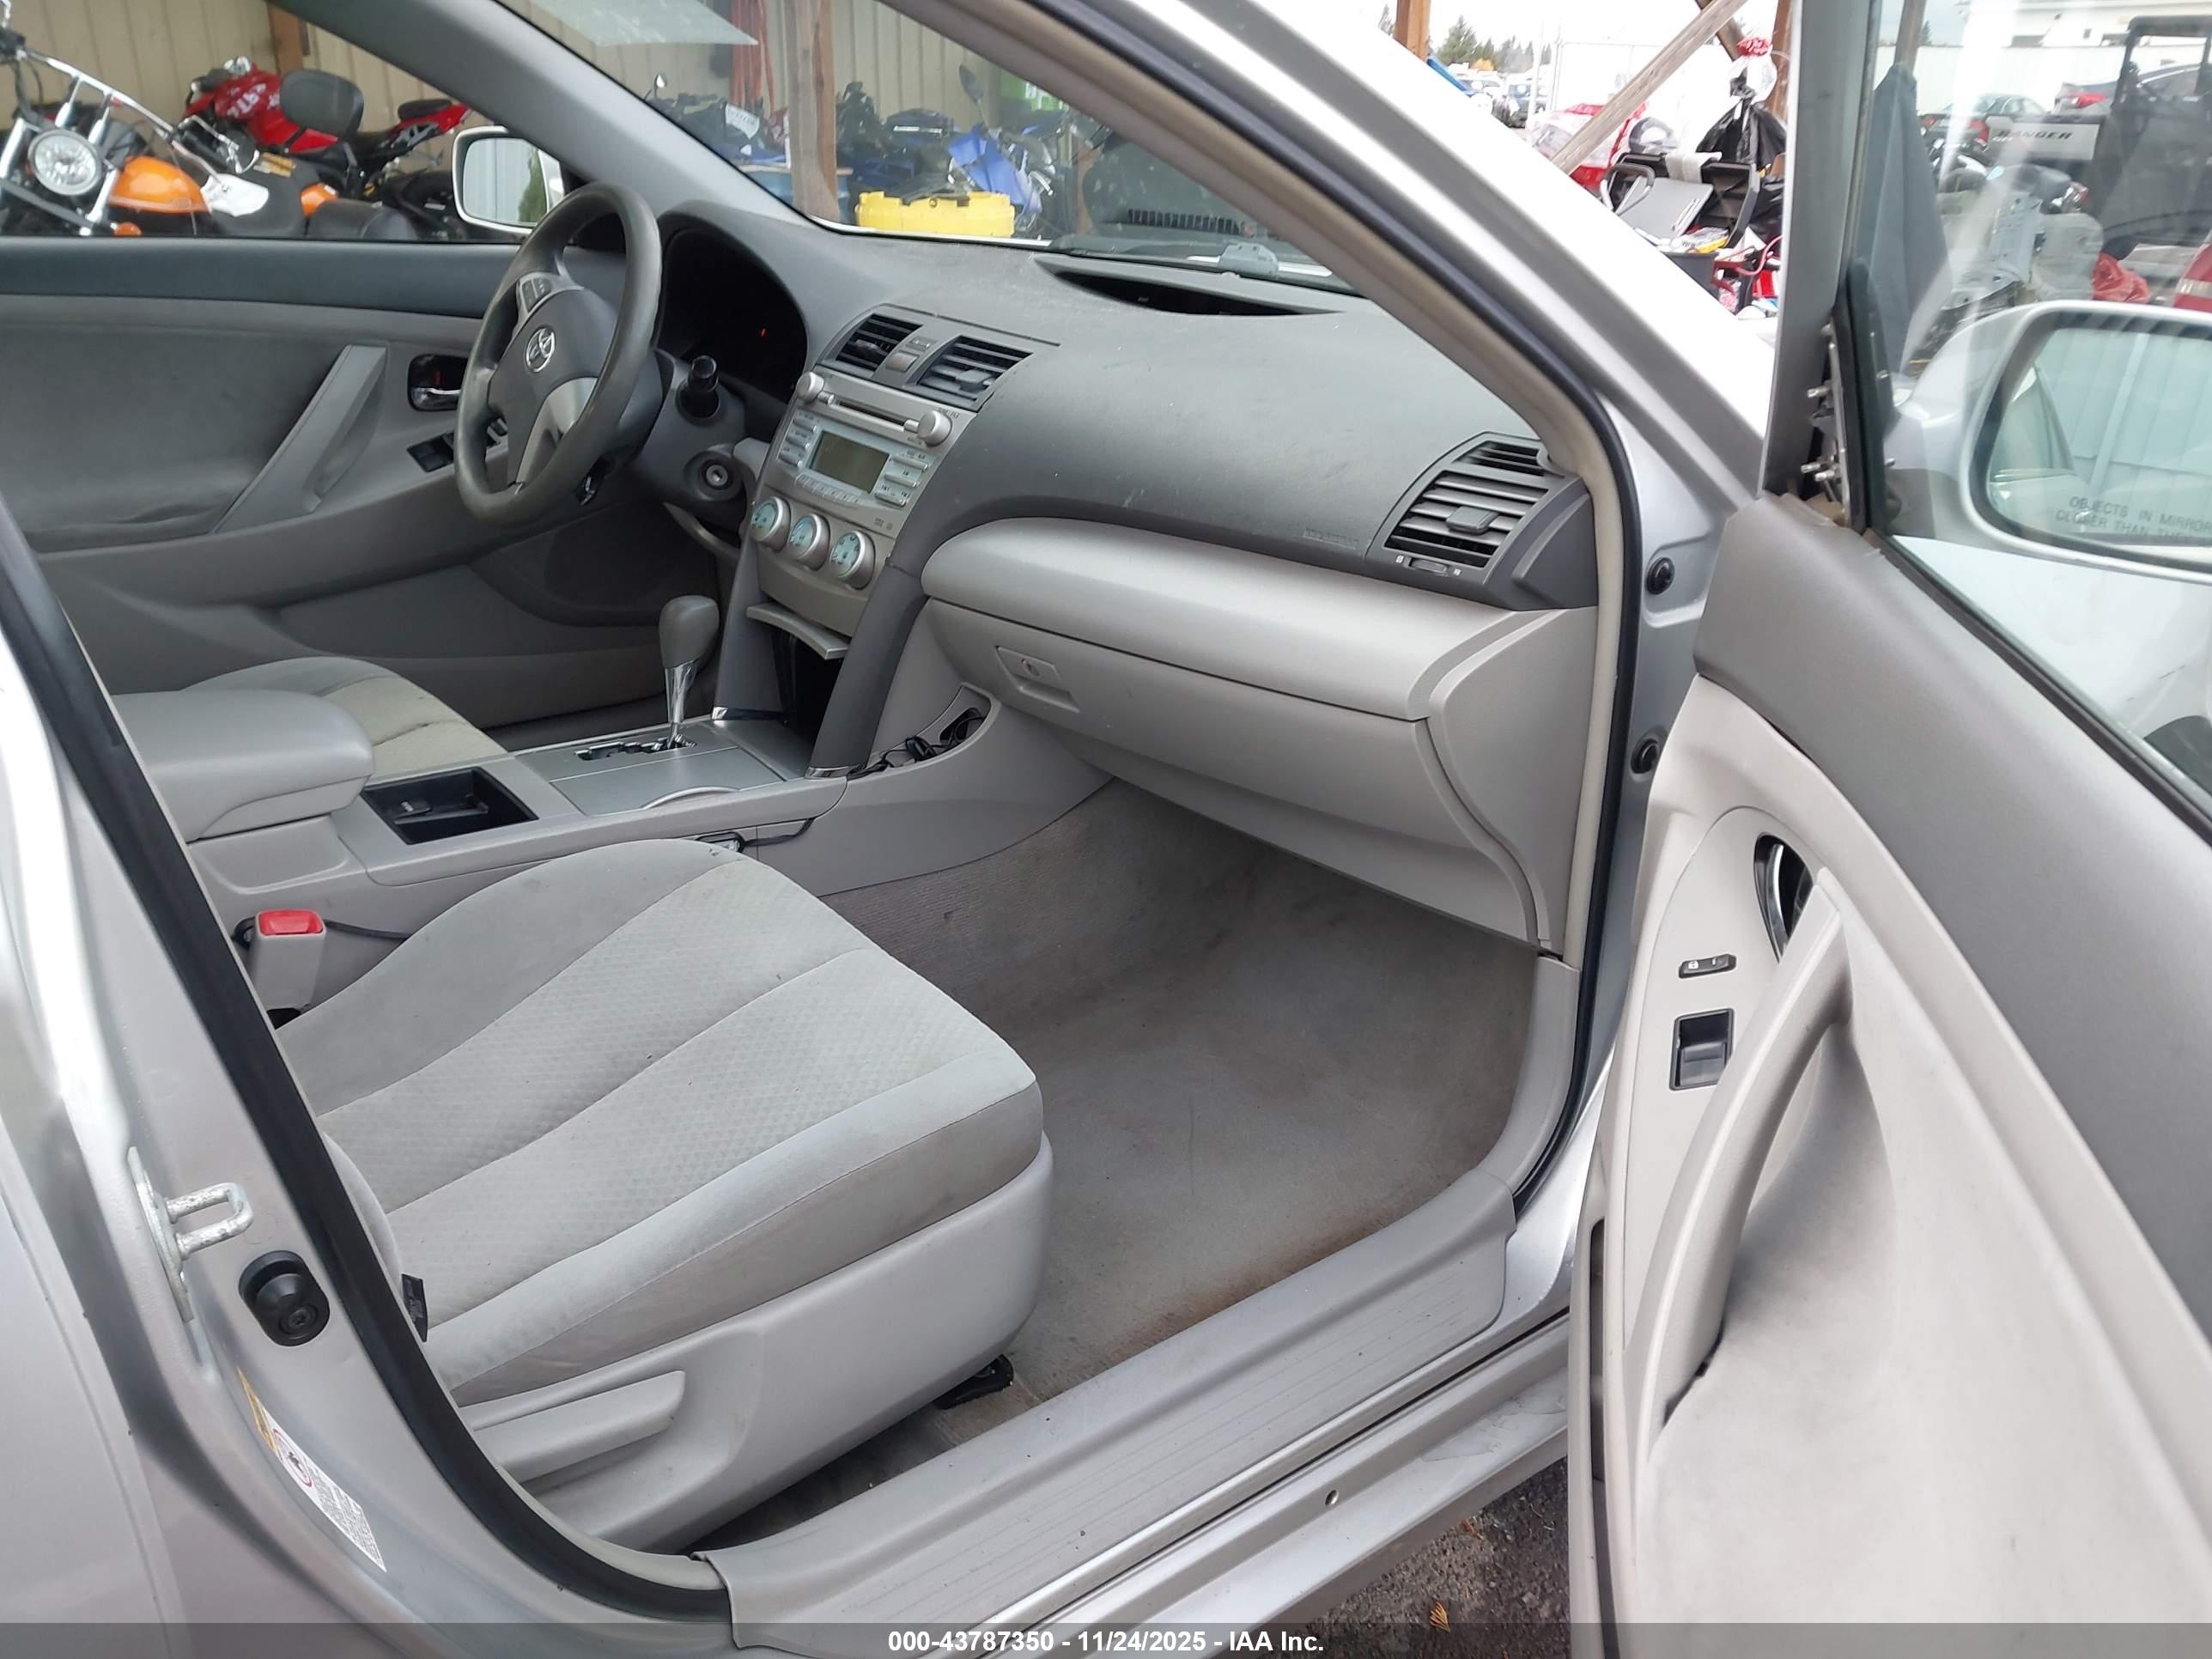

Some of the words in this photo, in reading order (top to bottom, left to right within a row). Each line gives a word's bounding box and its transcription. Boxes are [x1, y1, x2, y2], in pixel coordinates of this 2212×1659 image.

[2055, 508, 2108, 528] CLOSER
[2115, 520, 2150, 537] THAN
[2069, 495, 2130, 519] OBJECTS
[2138, 509, 2153, 523] IN
